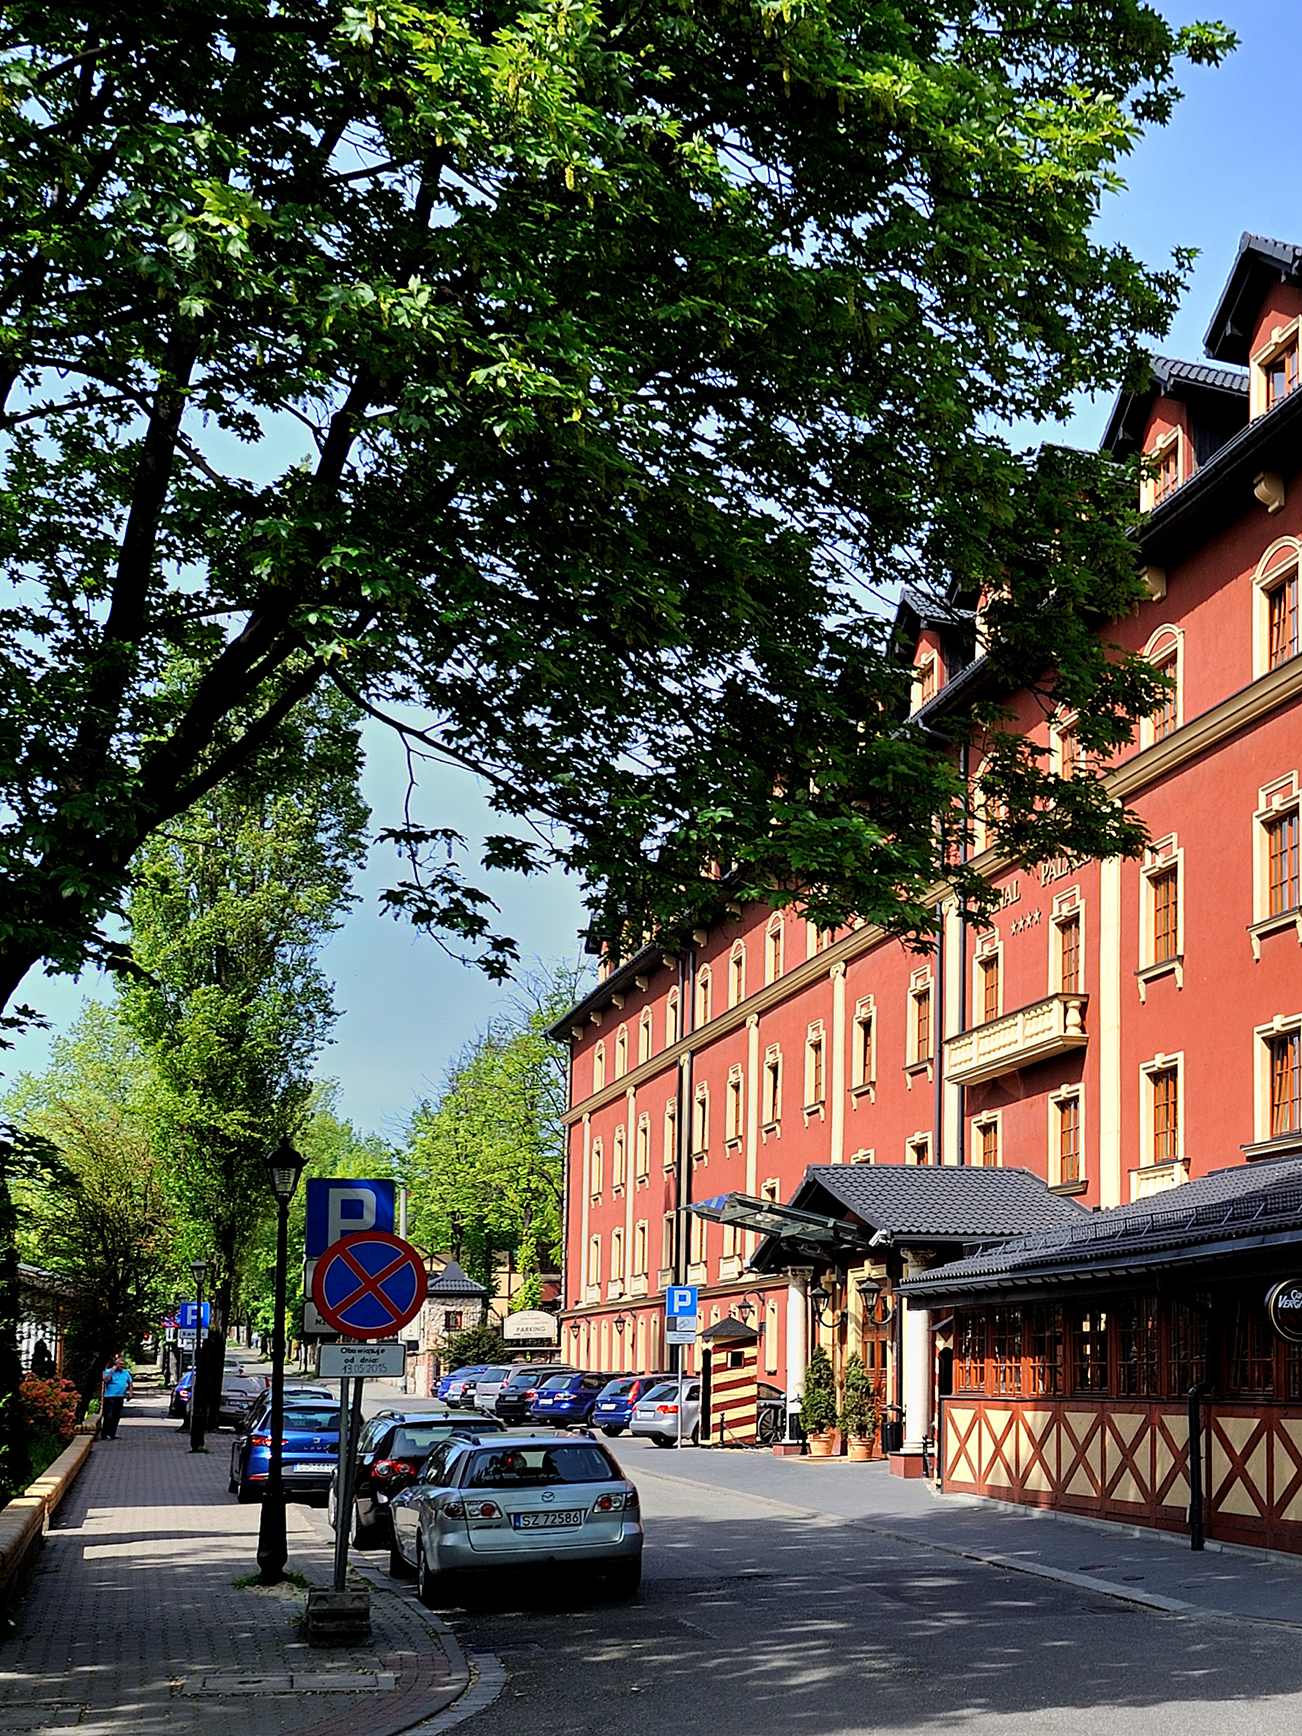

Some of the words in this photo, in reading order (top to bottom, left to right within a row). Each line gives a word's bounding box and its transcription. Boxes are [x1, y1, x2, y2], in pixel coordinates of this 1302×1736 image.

[328, 1188, 377, 1248] P
[674, 1290, 691, 1313] P
[187, 1305, 204, 1325] P
[522, 1516, 539, 1527] SZ
[543, 1512, 579, 1526] 72586
